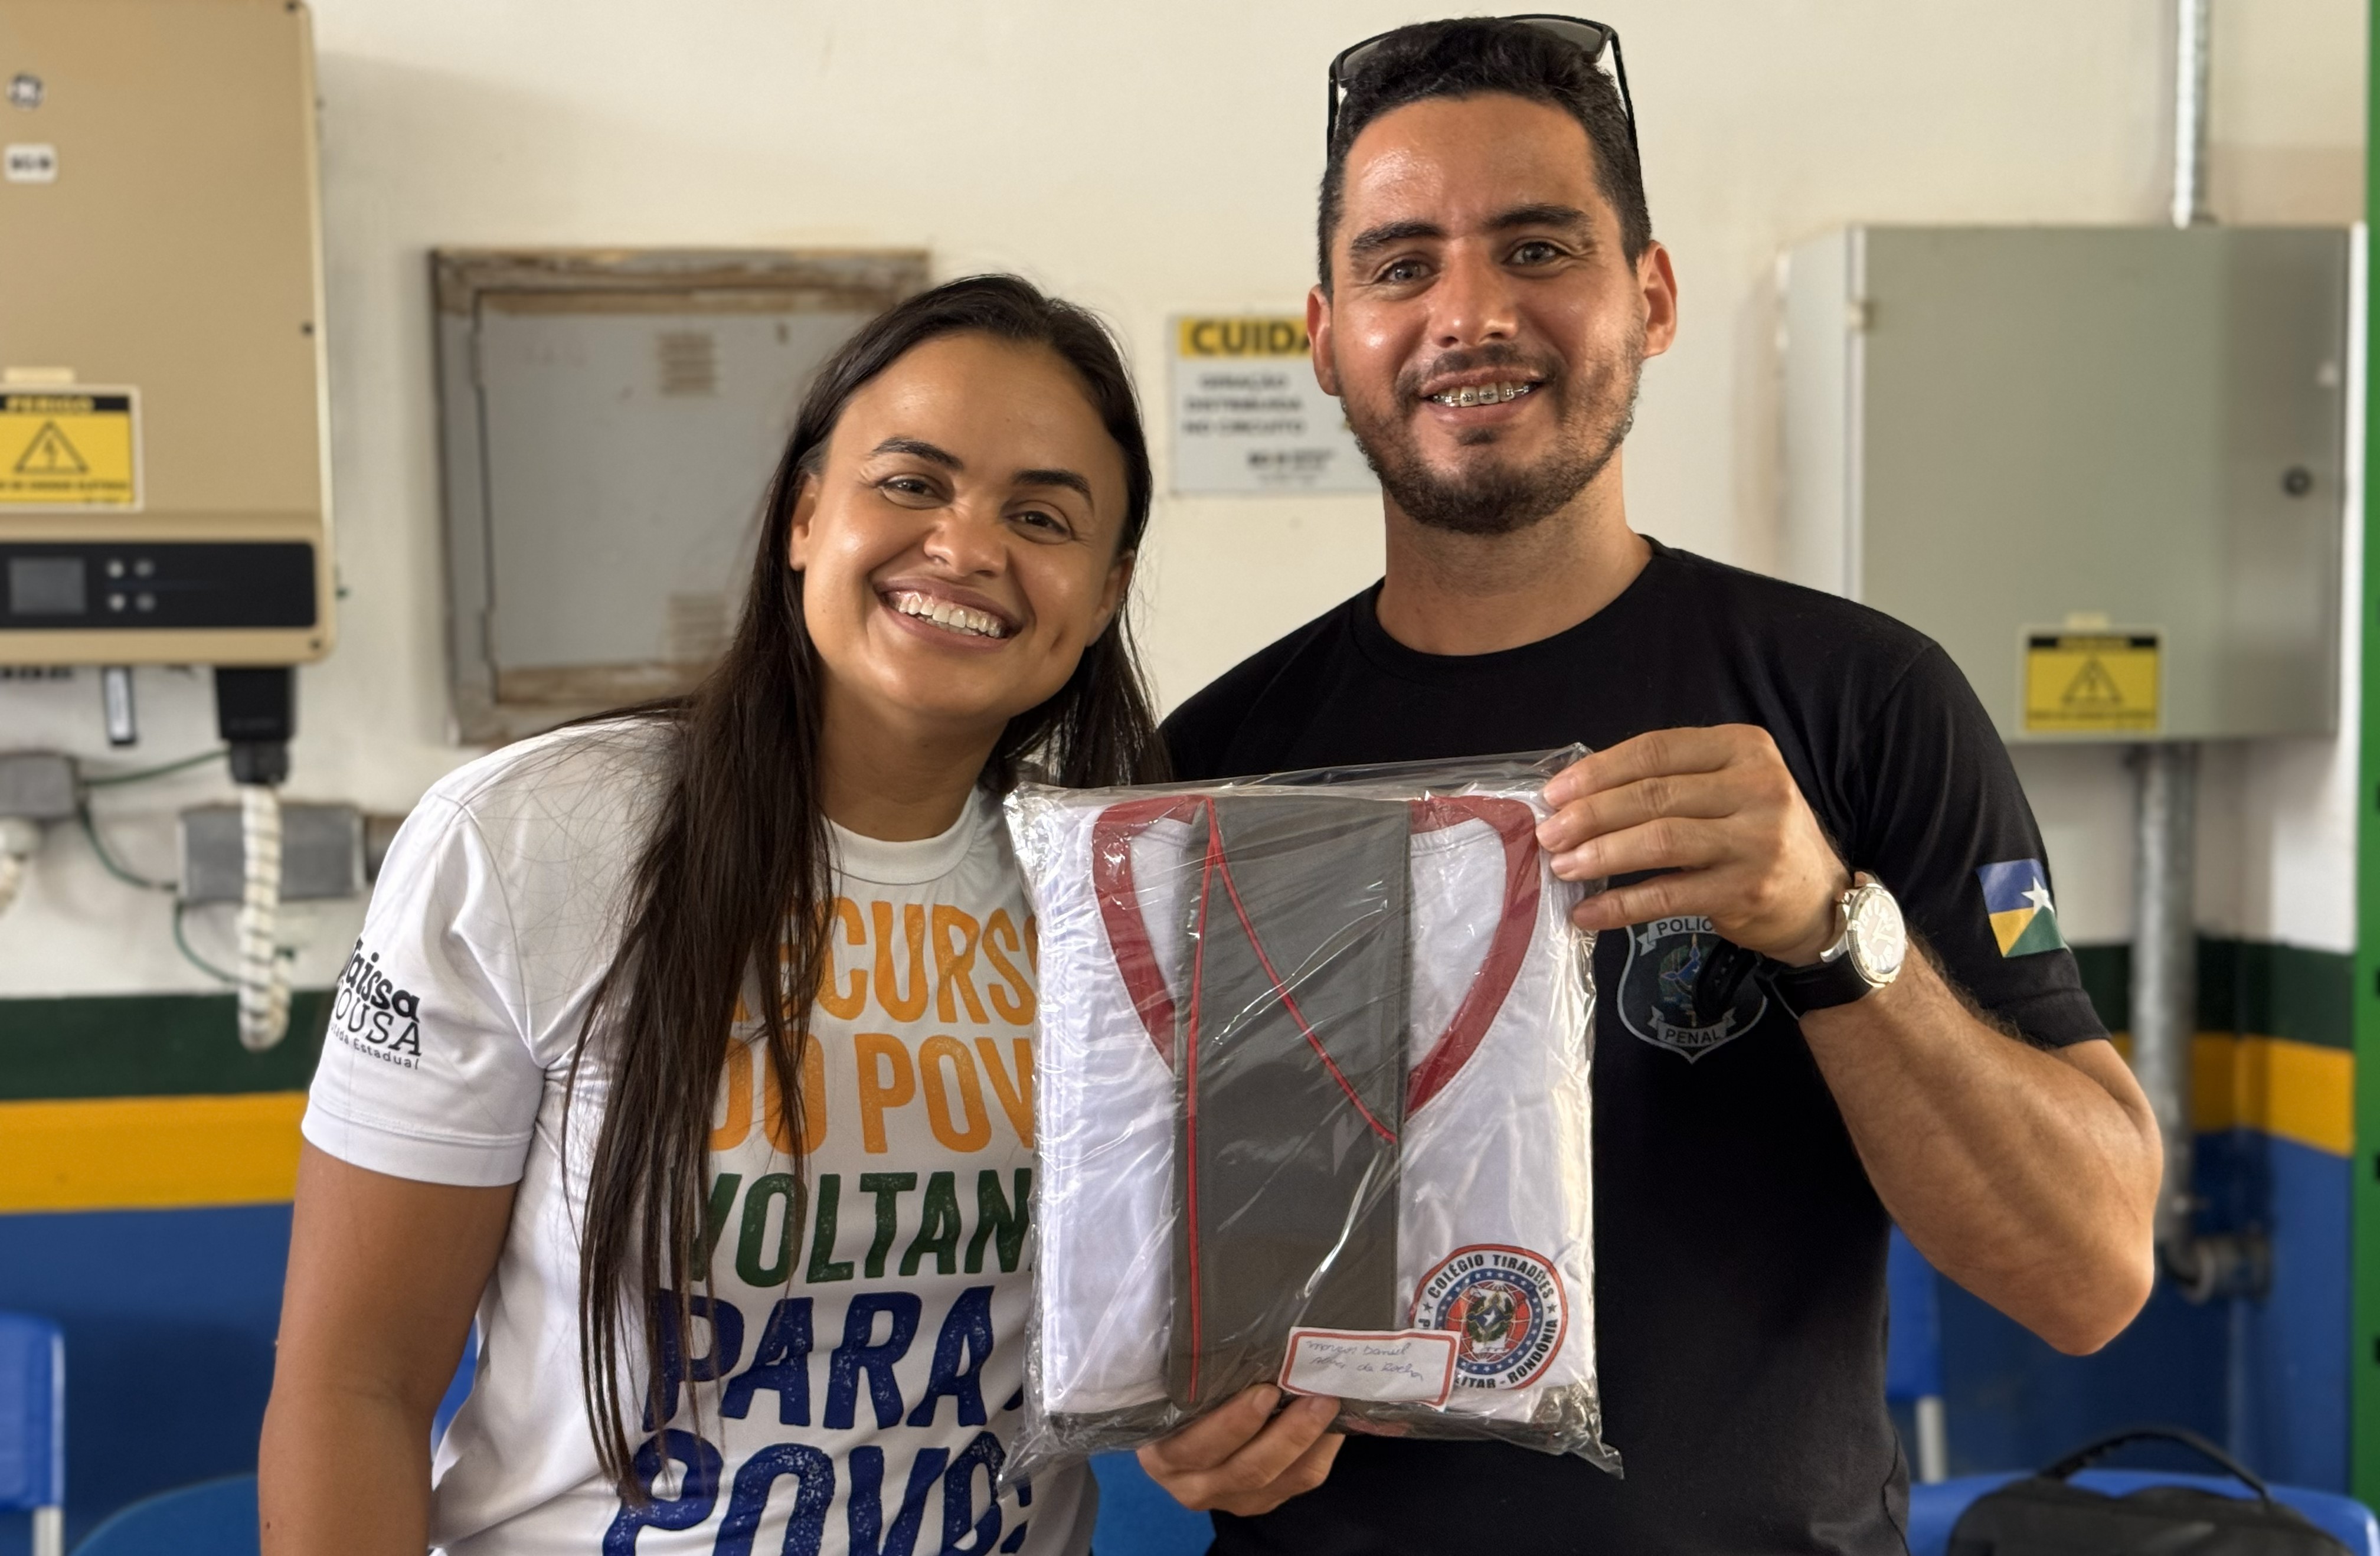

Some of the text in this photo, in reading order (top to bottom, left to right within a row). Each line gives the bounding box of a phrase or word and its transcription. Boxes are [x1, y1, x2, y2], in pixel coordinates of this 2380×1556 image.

[1191, 319, 1310, 355] CUID
[1656, 917, 1713, 936] POLIC
[732, 895, 1037, 1025] CURS
[336, 988, 421, 1057] OUSA
[354, 1038, 419, 1070] Estadual
[1665, 1028, 1719, 1044] PENAL
[854, 1034, 1034, 1155] POV
[673, 1169, 1033, 1289] VOLTAN
[1427, 1254, 1484, 1299] COLÉGIO
[643, 1285, 994, 1432] PARA
[1507, 1319, 1558, 1384] RONDÔNIA
